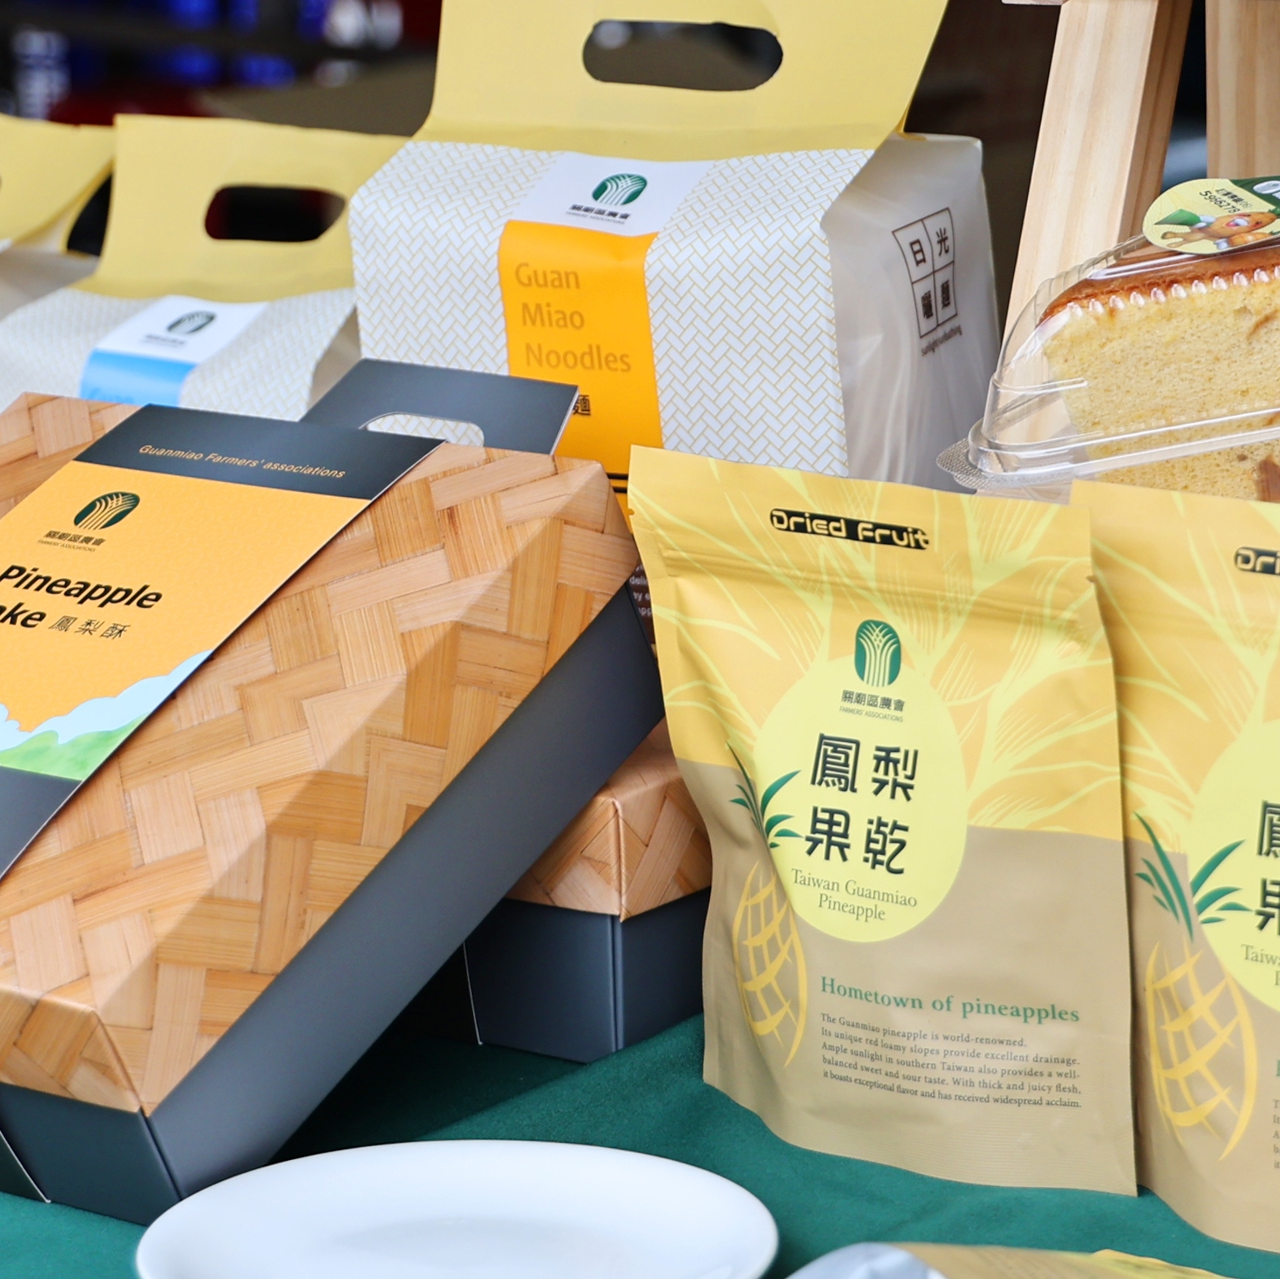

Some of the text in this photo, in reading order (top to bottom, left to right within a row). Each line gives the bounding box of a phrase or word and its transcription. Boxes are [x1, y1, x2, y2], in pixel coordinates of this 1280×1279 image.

[909, 227, 949, 266] 日光
[515, 262, 580, 290] Guan
[521, 303, 584, 330] Miao
[525, 342, 631, 372] Noodles
[139, 444, 346, 479] Guanmiao Farmers' associations
[772, 509, 929, 549] Dried Fruit
[49, 615, 131, 640] 鳳梨酥
[810, 732, 919, 801] 鳳梨
[804, 805, 910, 875] 果乾
[790, 868, 917, 908] Taiwan Guanmiao
[818, 893, 885, 922] Pineapple
[821, 976, 1080, 1025] Hometown of pineapples
[820, 1013, 1027, 1047] The Guanmiao pineapple is world-renowned.
[821, 1027, 1080, 1067] Its unique red loamy slopes provide excellent drainage.
[821, 1041, 848, 1054] Ample
[850, 1049, 883, 1062] sunlight
[885, 1055, 894, 1064] in
[896, 1058, 937, 1070] southern
[940, 1061, 974, 1073] Taiwan
[978, 1064, 998, 1075] also
[1000, 1068, 1044, 1078] provides
[1056, 1070, 1080, 1079] well-
[822, 1054, 1082, 1094] balanced sweet and sour taste. With thick and juicy flesh,
[823, 1069, 1082, 1108] it boasts exceptional flavor and has received widespread acclaim.
